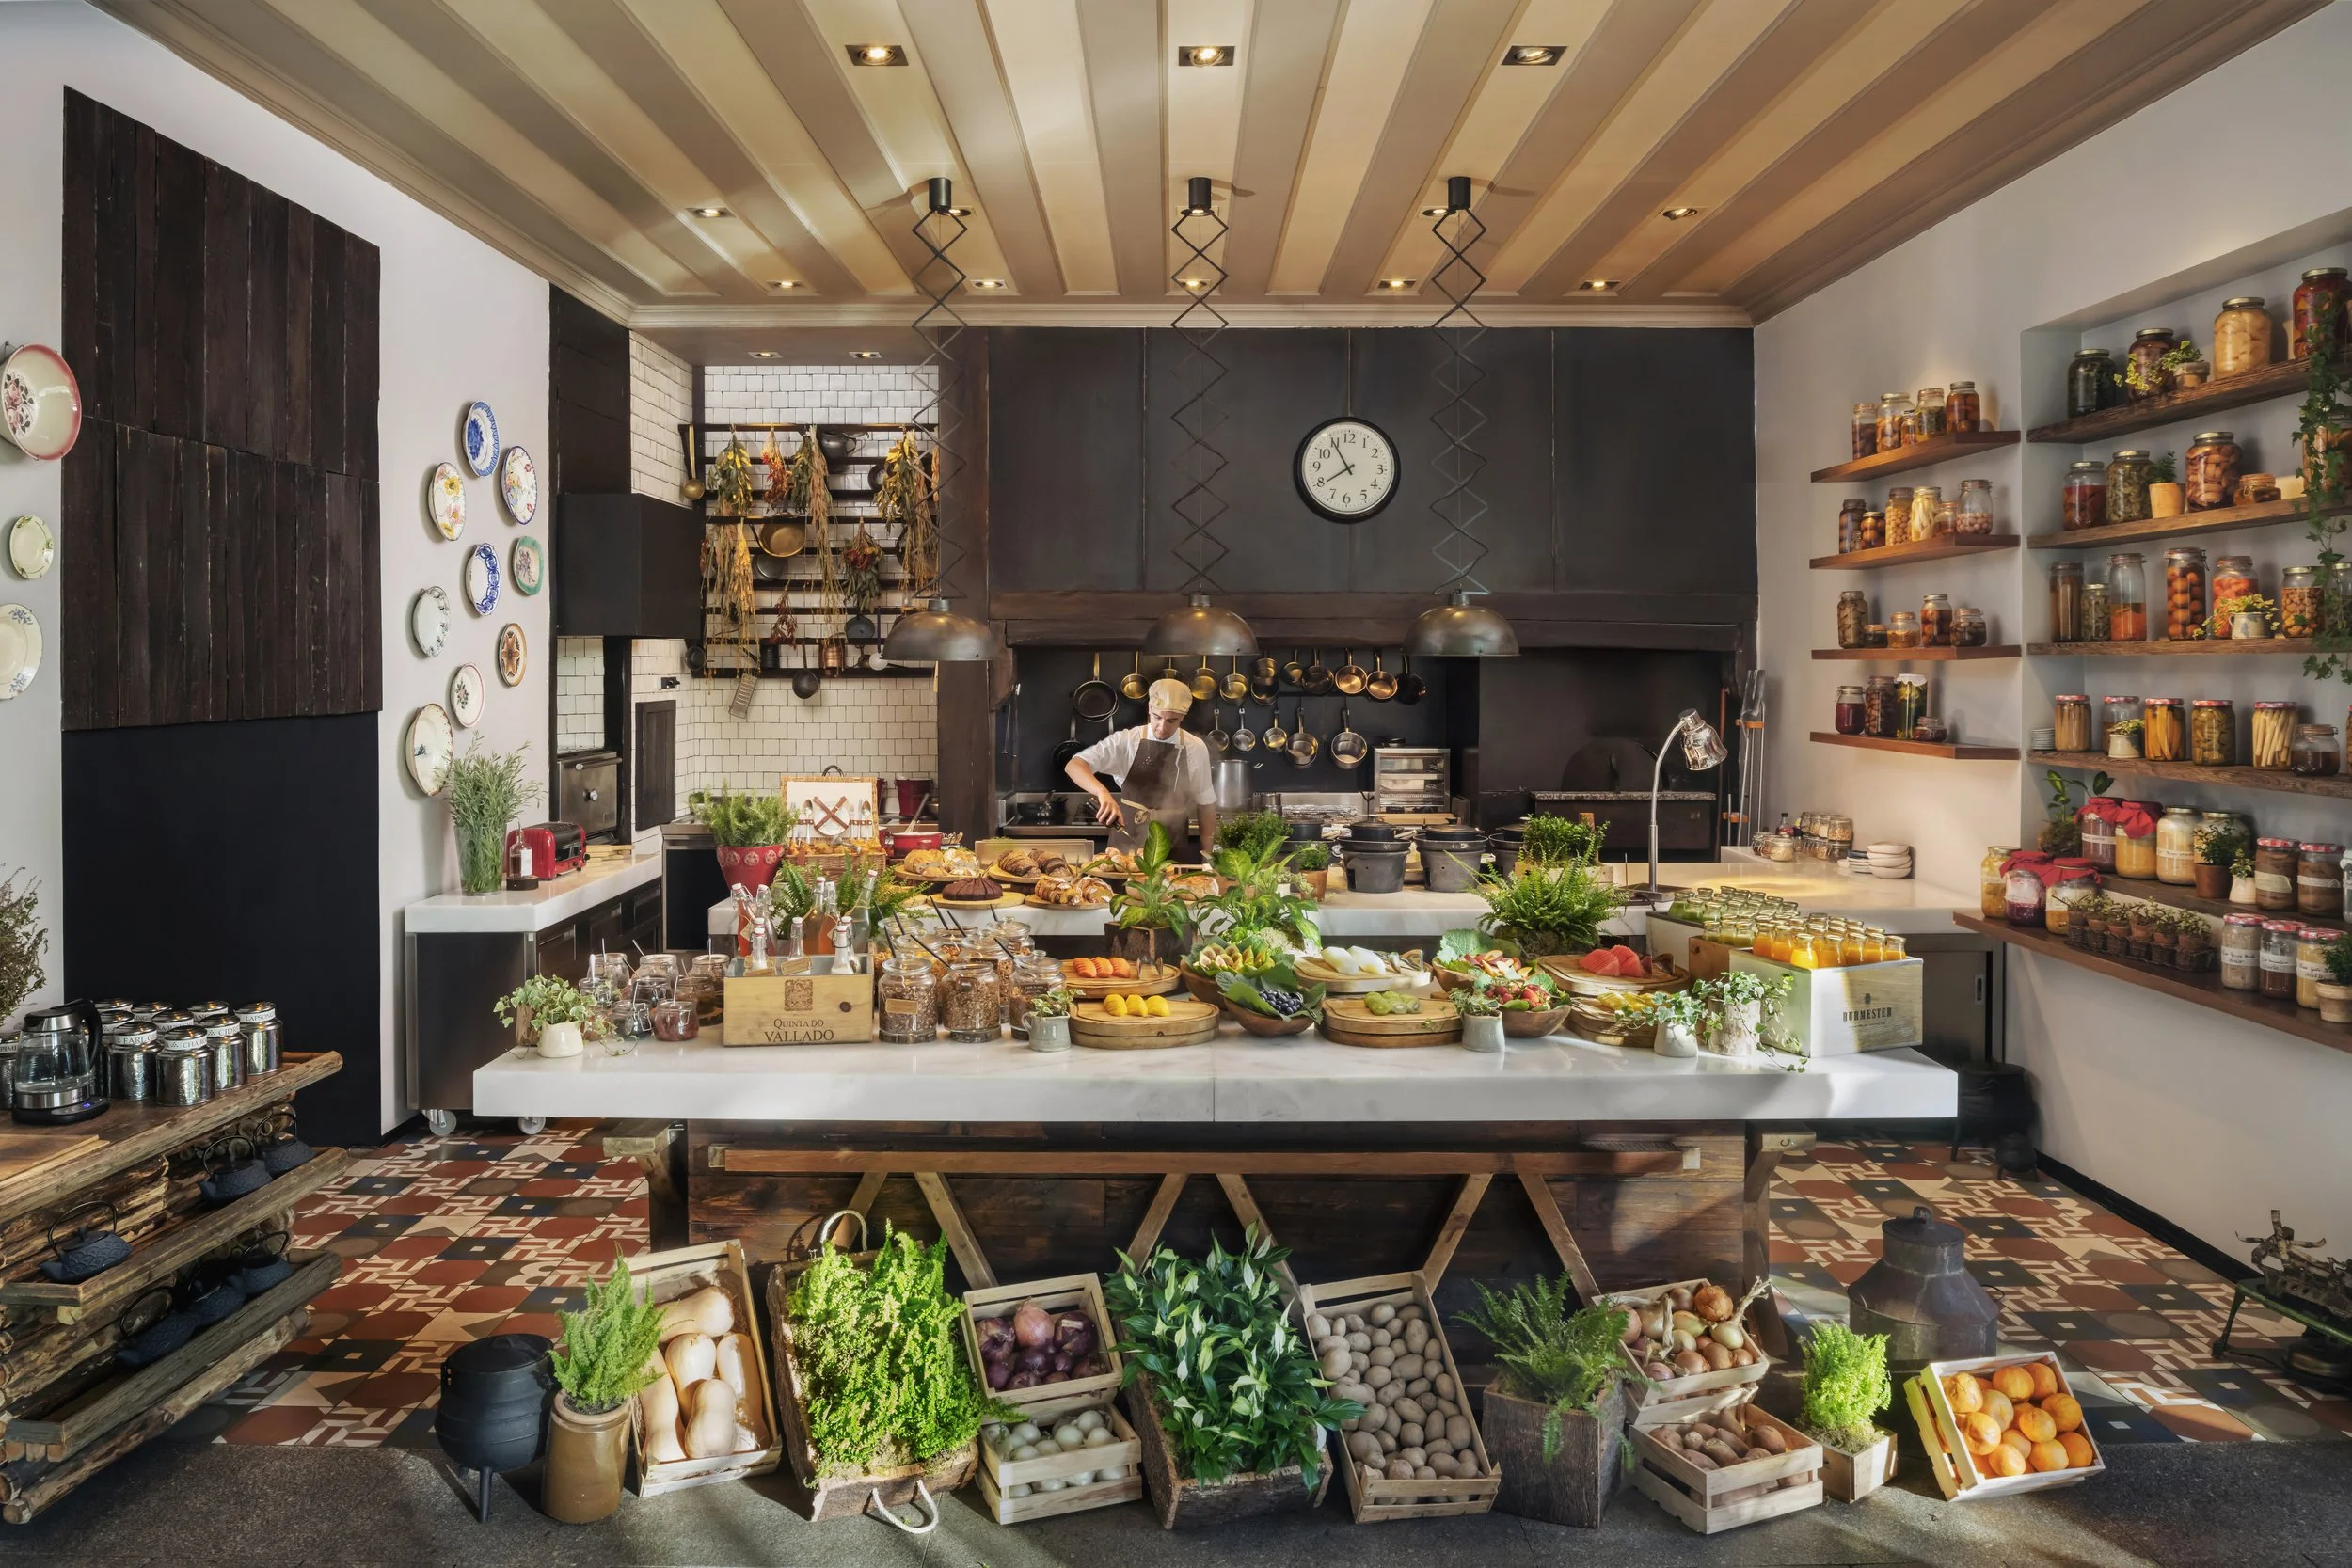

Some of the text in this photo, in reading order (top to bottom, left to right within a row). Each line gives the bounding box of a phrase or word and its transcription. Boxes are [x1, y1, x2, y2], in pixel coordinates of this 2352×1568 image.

[1343, 433, 1356, 444] 12
[1319, 448, 1331, 460] 10
[1371, 448, 1378, 459] 2
[1312, 461, 1321, 472] 9
[1376, 464, 1384, 475] 3
[1316, 477, 1325, 488] 8
[1370, 478, 1378, 489] 4
[1329, 488, 1337, 499] 7
[1343, 492, 1351, 504] 6
[1359, 489, 1368, 500] 5
[1842, 1007, 1892, 1022] BURMESTER
[773, 1019, 824, 1030] QUINTA DO
[764, 1029, 834, 1042] VALLADO
